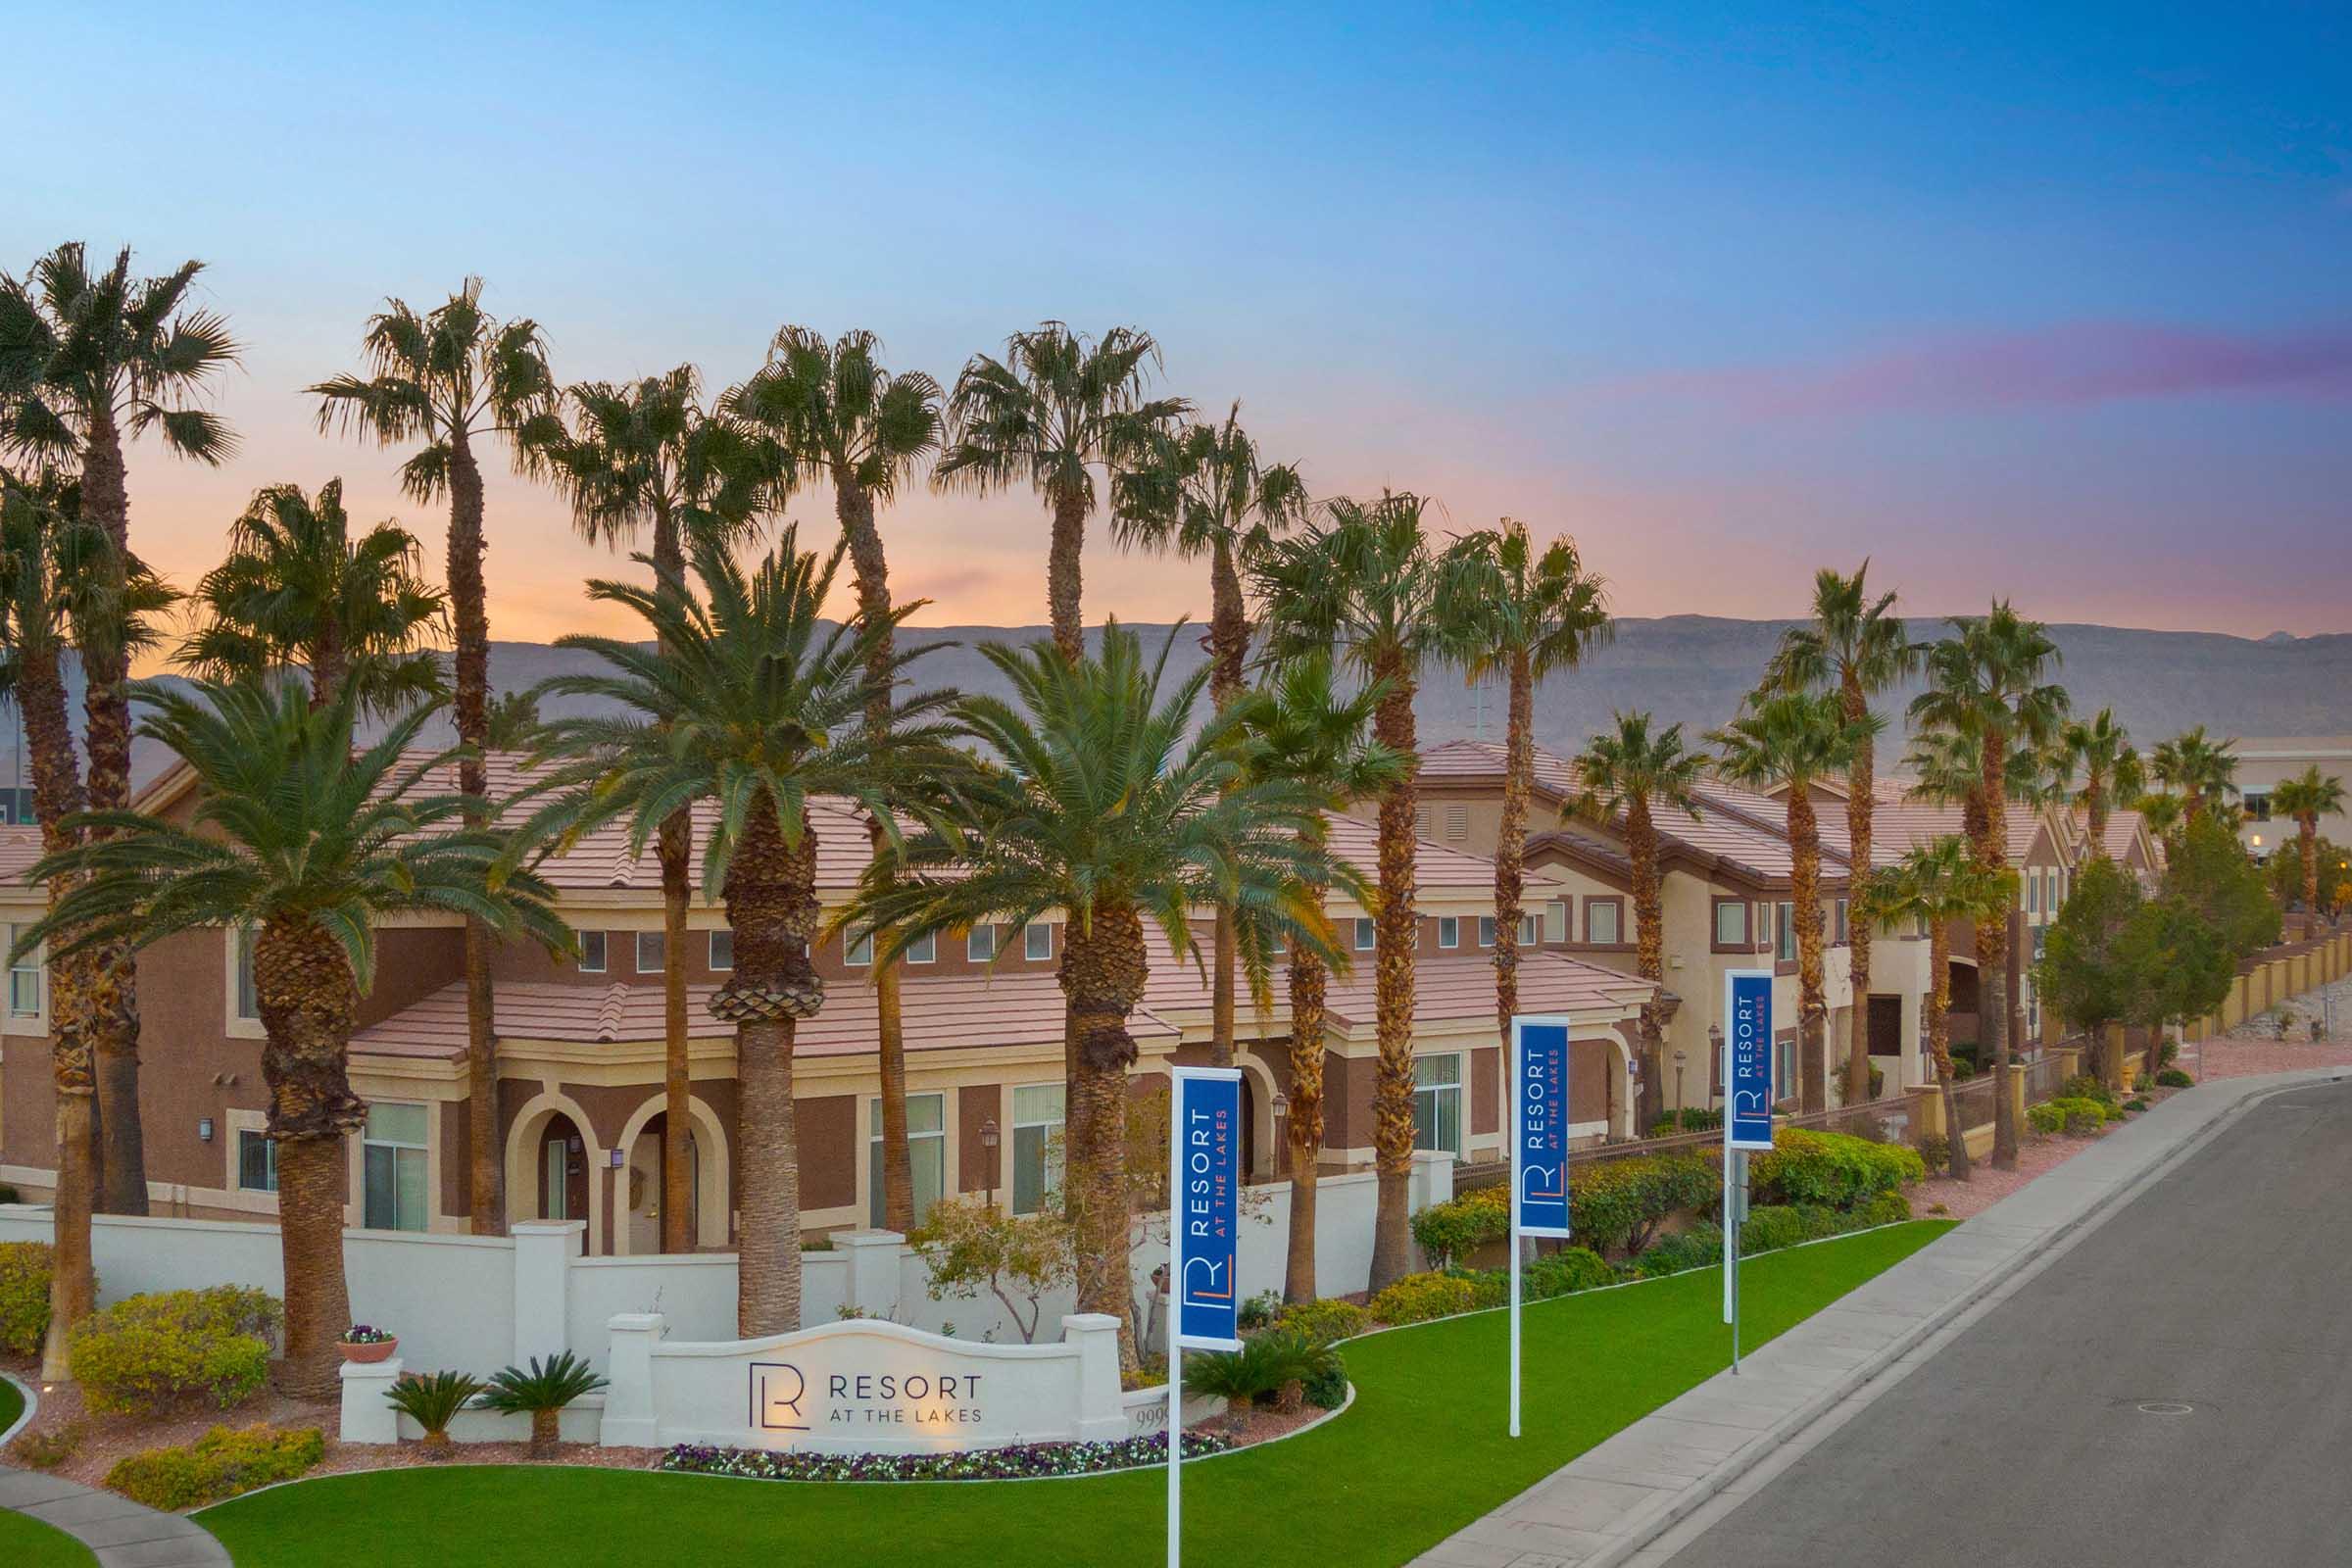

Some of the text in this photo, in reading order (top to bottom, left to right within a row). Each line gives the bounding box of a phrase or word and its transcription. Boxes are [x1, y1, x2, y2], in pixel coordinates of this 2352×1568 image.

[1738, 996, 1752, 1078] RESORT
[1755, 996, 1764, 1077] AT THE LAKES
[1528, 1050, 1544, 1150] RESORT
[1548, 1050, 1558, 1149] AT THE LAKES
[1191, 1108, 1209, 1237] RESORT
[1214, 1109, 1227, 1237] AT THE LAKES
[829, 1375, 982, 1400] RESORT
[829, 1408, 982, 1423] AT THE LAKES
